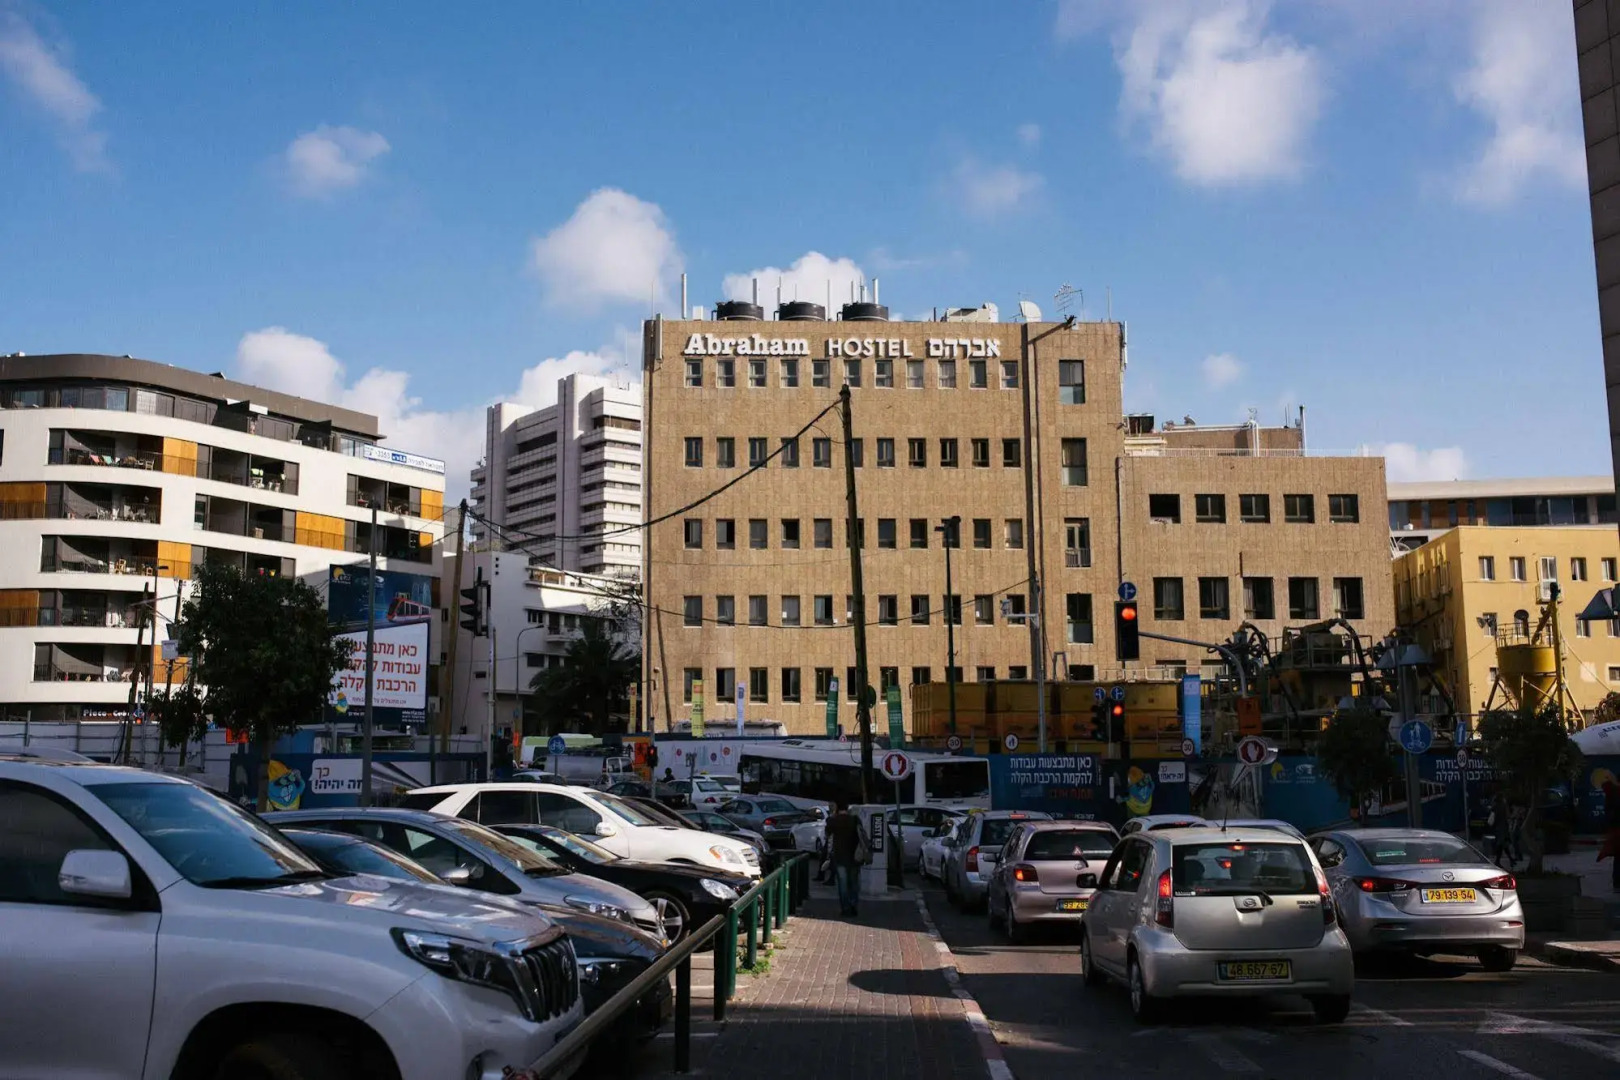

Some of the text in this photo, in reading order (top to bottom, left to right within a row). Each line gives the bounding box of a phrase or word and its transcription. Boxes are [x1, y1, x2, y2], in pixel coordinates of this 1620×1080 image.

[683, 333, 914, 357] Abraham HOSTEL
[929, 337, 1002, 358] אברהם
[398, 644, 418, 658] כאן
[382, 660, 421, 675] עבודות
[376, 678, 417, 693] הרכבת
[1009, 756, 1093, 771] כאן מתבצעות עבודות
[315, 767, 330, 779] כך
[1010, 770, 1093, 787] להקמת הרכבת הקלה
[1435, 769, 1461, 784] הקלה
[314, 779, 363, 790] זה יהיה!
